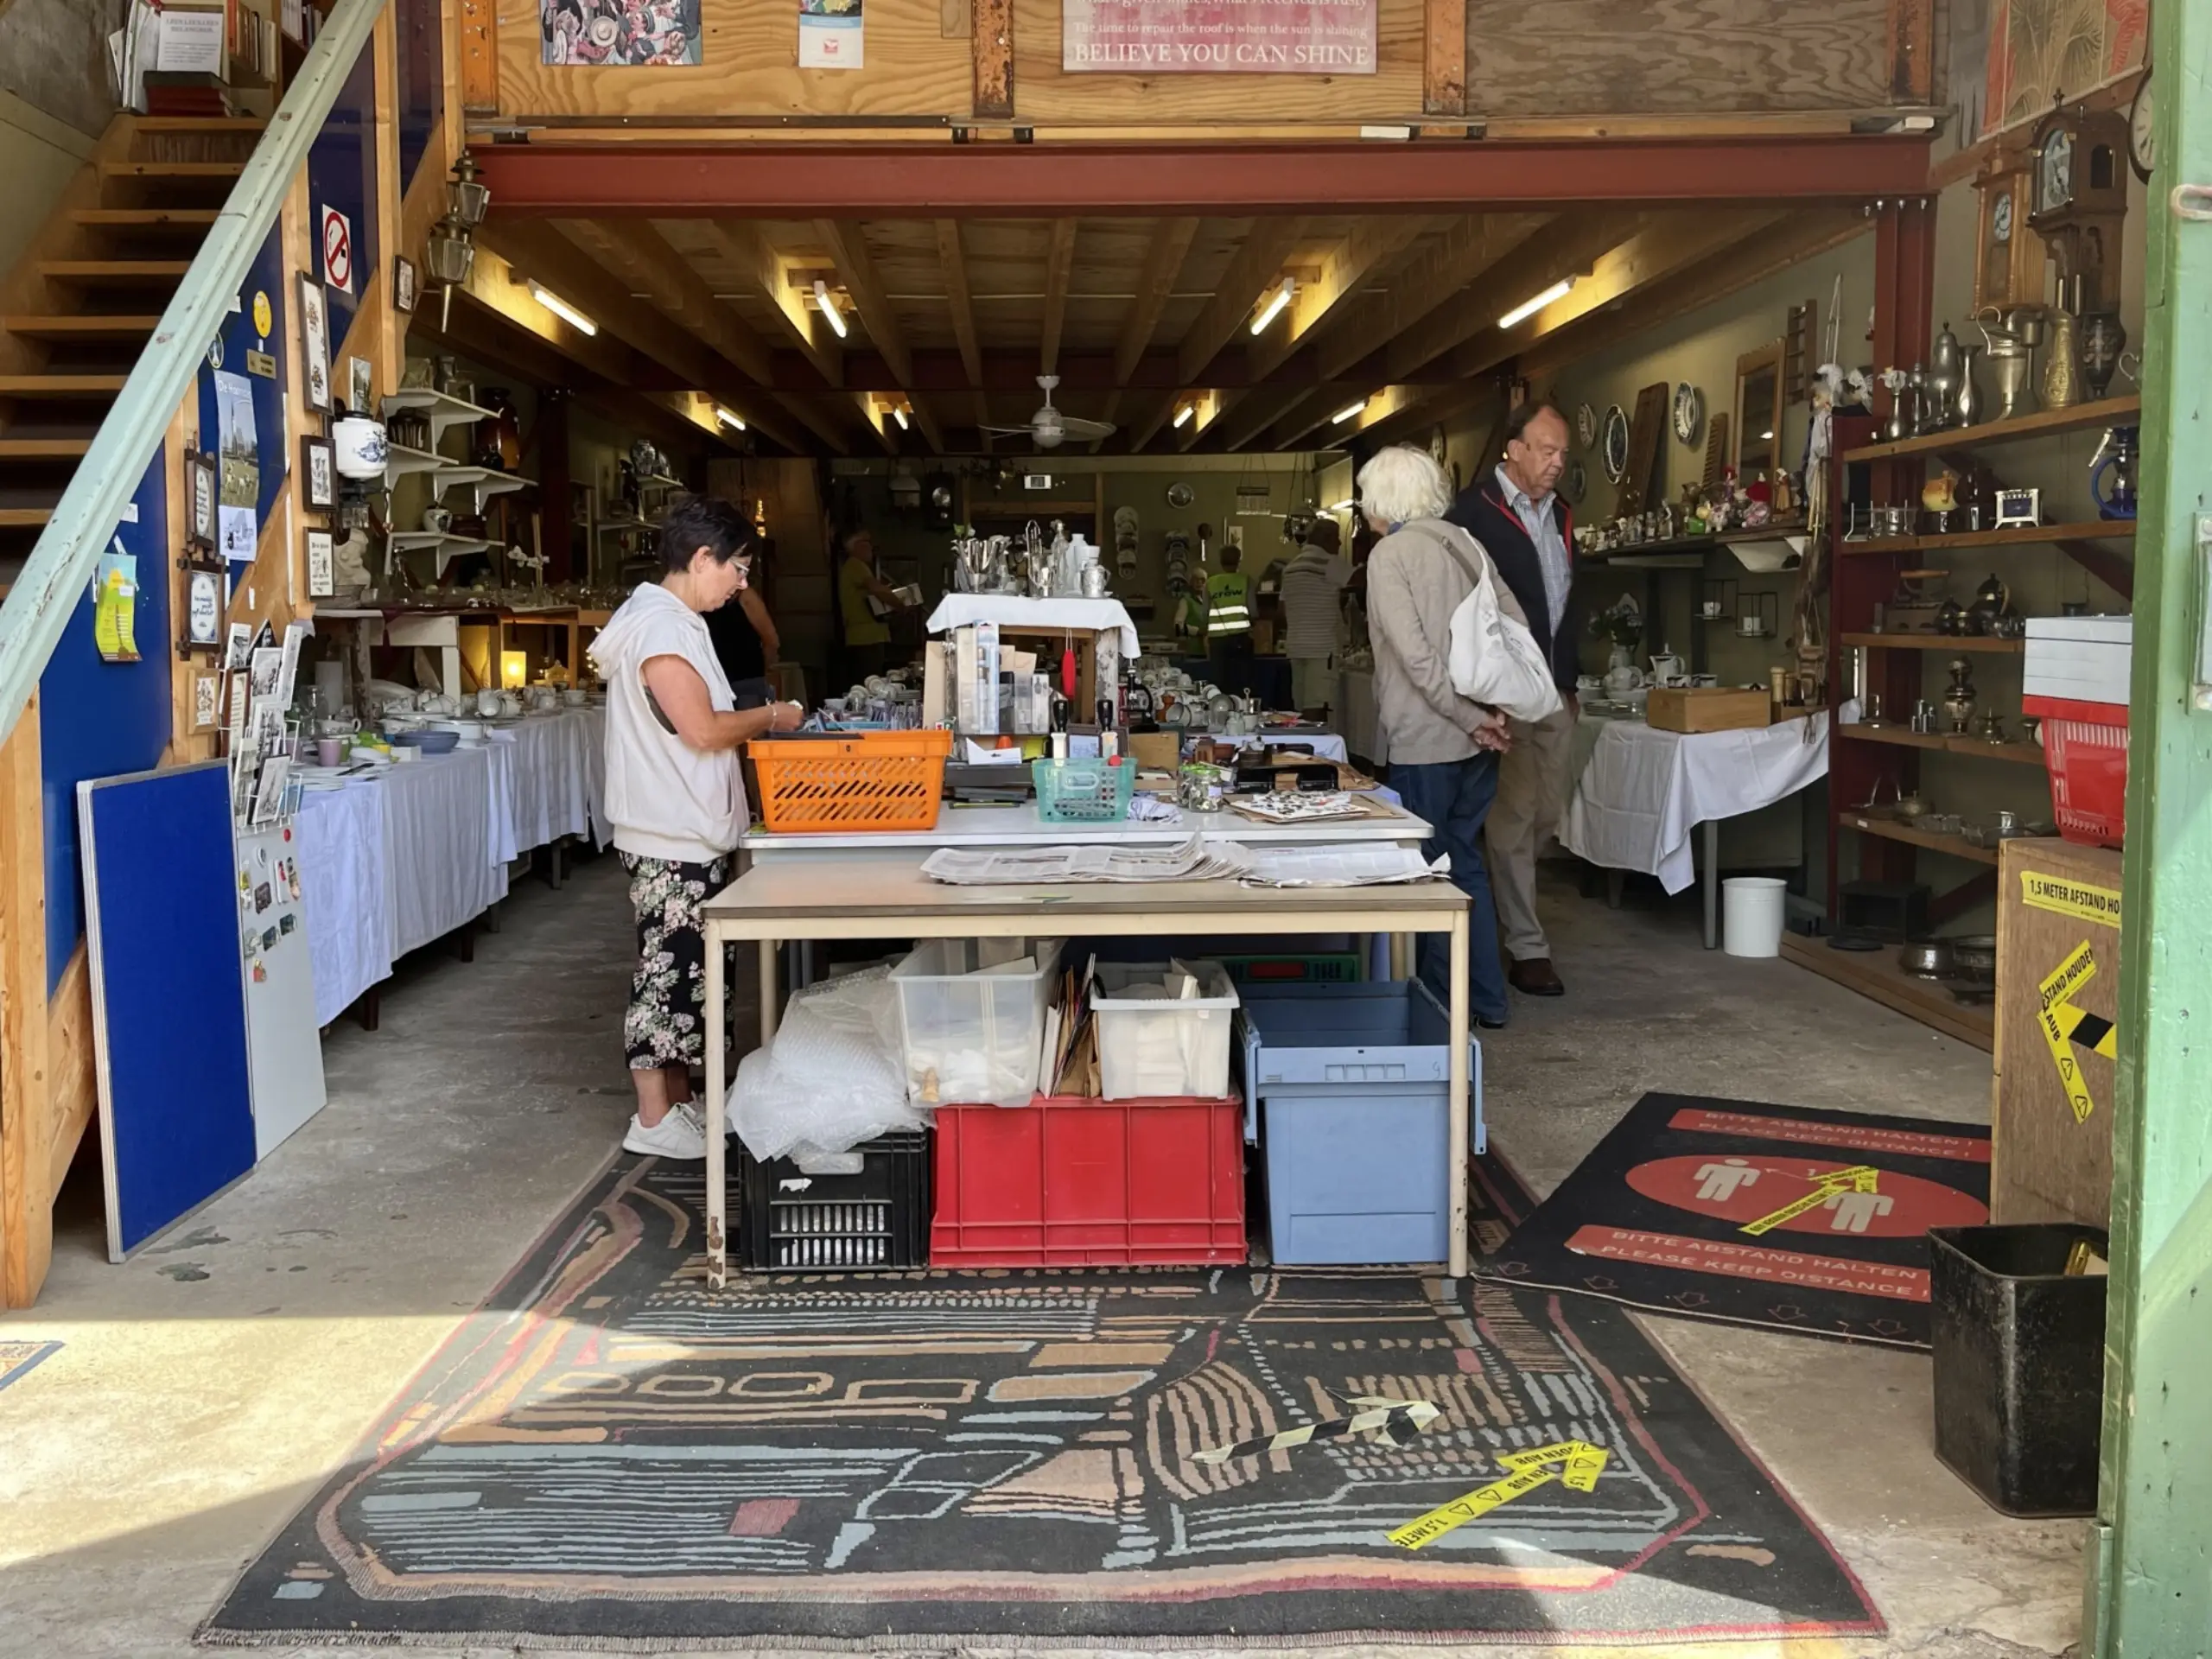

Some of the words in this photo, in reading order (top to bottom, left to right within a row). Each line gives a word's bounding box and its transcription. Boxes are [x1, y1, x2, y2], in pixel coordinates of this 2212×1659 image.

[1073, 22, 1096, 33] The
[1099, 22, 1124, 33] time
[1128, 23, 1139, 33] to
[1142, 23, 1174, 35] repair
[1178, 22, 1196, 33] the
[1199, 22, 1224, 33] roof
[1225, 23, 1234, 33] is
[1237, 23, 1267, 34] when
[1270, 23, 1288, 34] the
[1314, 23, 1323, 35] is
[1325, 23, 1368, 39] shining
[1075, 44, 1172, 62] BELIEVE
[1178, 44, 1229, 62] YOU
[1236, 44, 1287, 63] CAN
[1294, 45, 1370, 65] SHINE
[2030, 879, 2042, 895] 1,5
[2044, 882, 2068, 901] METER
[2070, 888, 2106, 911] AFSTAND
[2046, 1014, 2061, 1042] AUB
[1698, 1122, 1777, 1136] PLEASE
[1784, 1131, 1840, 1143] KEEP
[1847, 1139, 1956, 1156] DISTANCE
[1705, 1112, 1763, 1124] BITTE
[1769, 1120, 1866, 1135] ABSTAND
[1873, 1130, 1959, 1146] HALTEN
[1612, 1231, 1678, 1247] BITTE
[1687, 1242, 1803, 1264] ABSTAND
[1813, 1259, 1917, 1280] HALTEN
[1601, 1246, 1697, 1266] PLEASE
[1704, 1260, 1772, 1275] KEEP
[1780, 1270, 1913, 1295] DISTANCE
[1515, 1454, 1543, 1465] AUB
[1507, 1476, 1534, 1489] AUB
[1425, 1518, 1448, 1531] 1,5
